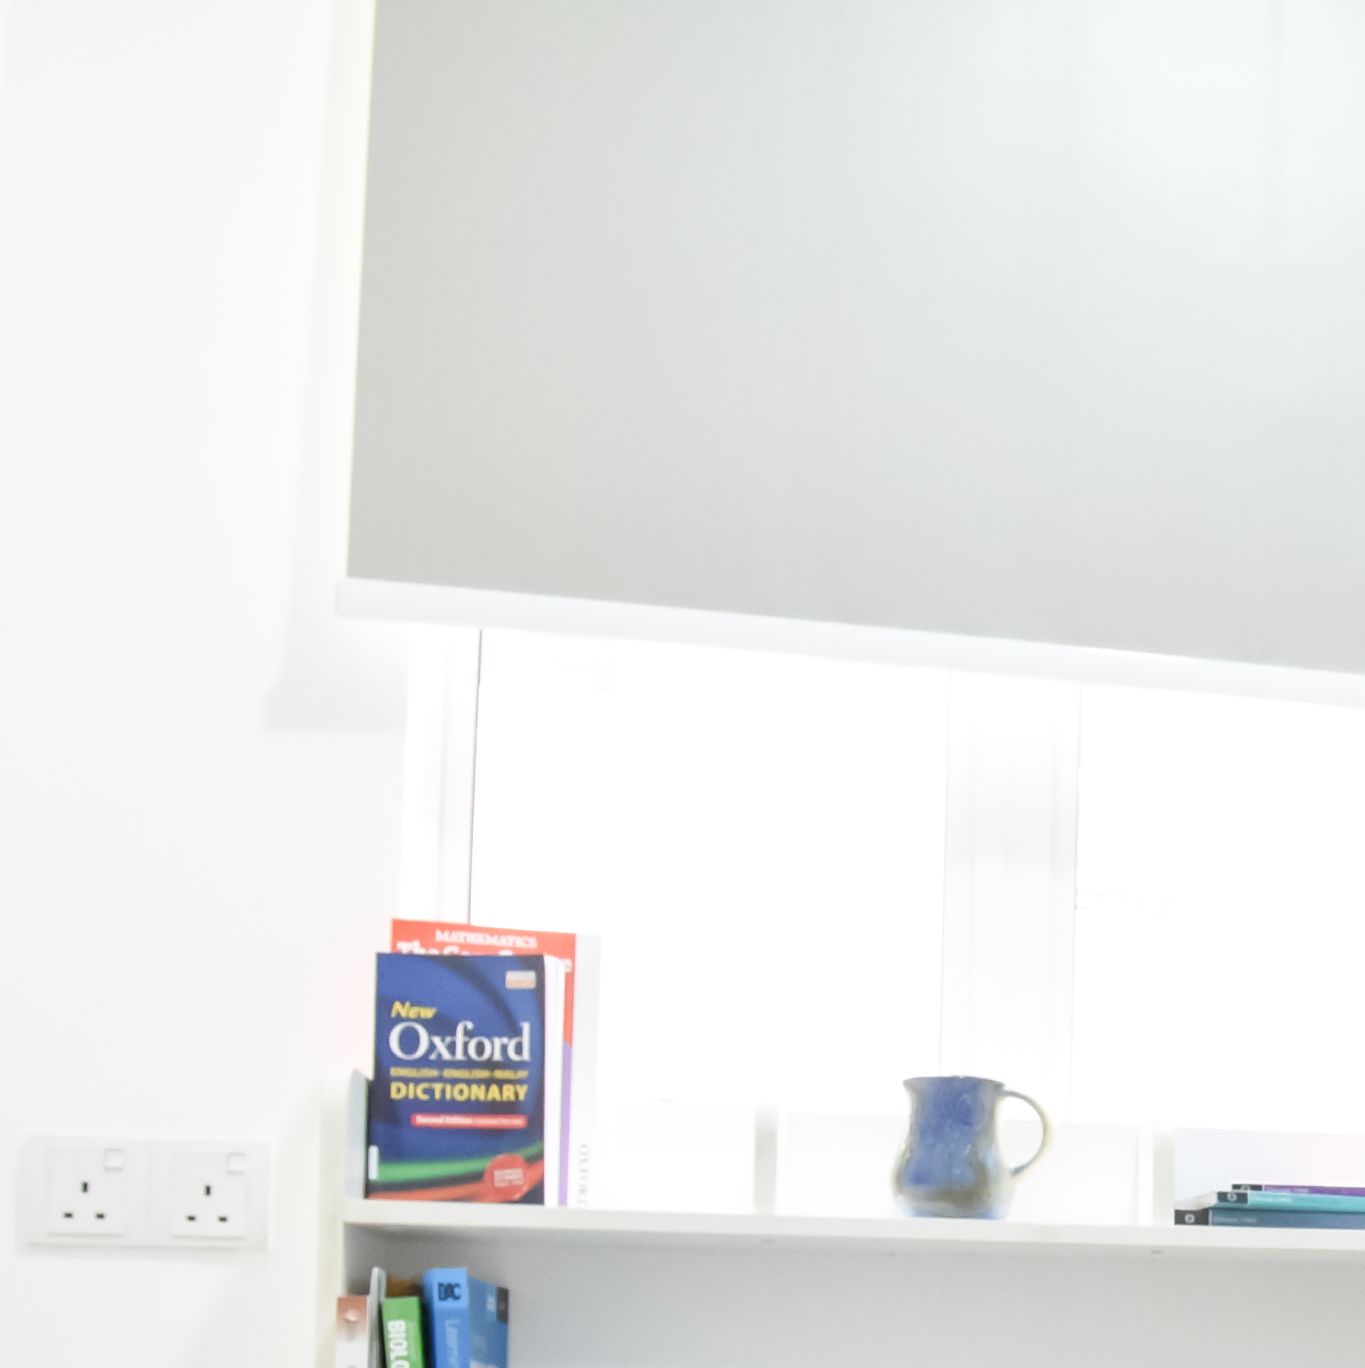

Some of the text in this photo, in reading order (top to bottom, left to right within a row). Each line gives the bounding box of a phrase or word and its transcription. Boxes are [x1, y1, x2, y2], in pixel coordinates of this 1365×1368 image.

[435, 929, 538, 949] MATHEMATICS
[391, 1001, 437, 1019] New
[389, 1020, 531, 1062] Oxford
[390, 1081, 529, 1101] DICTIONARY
